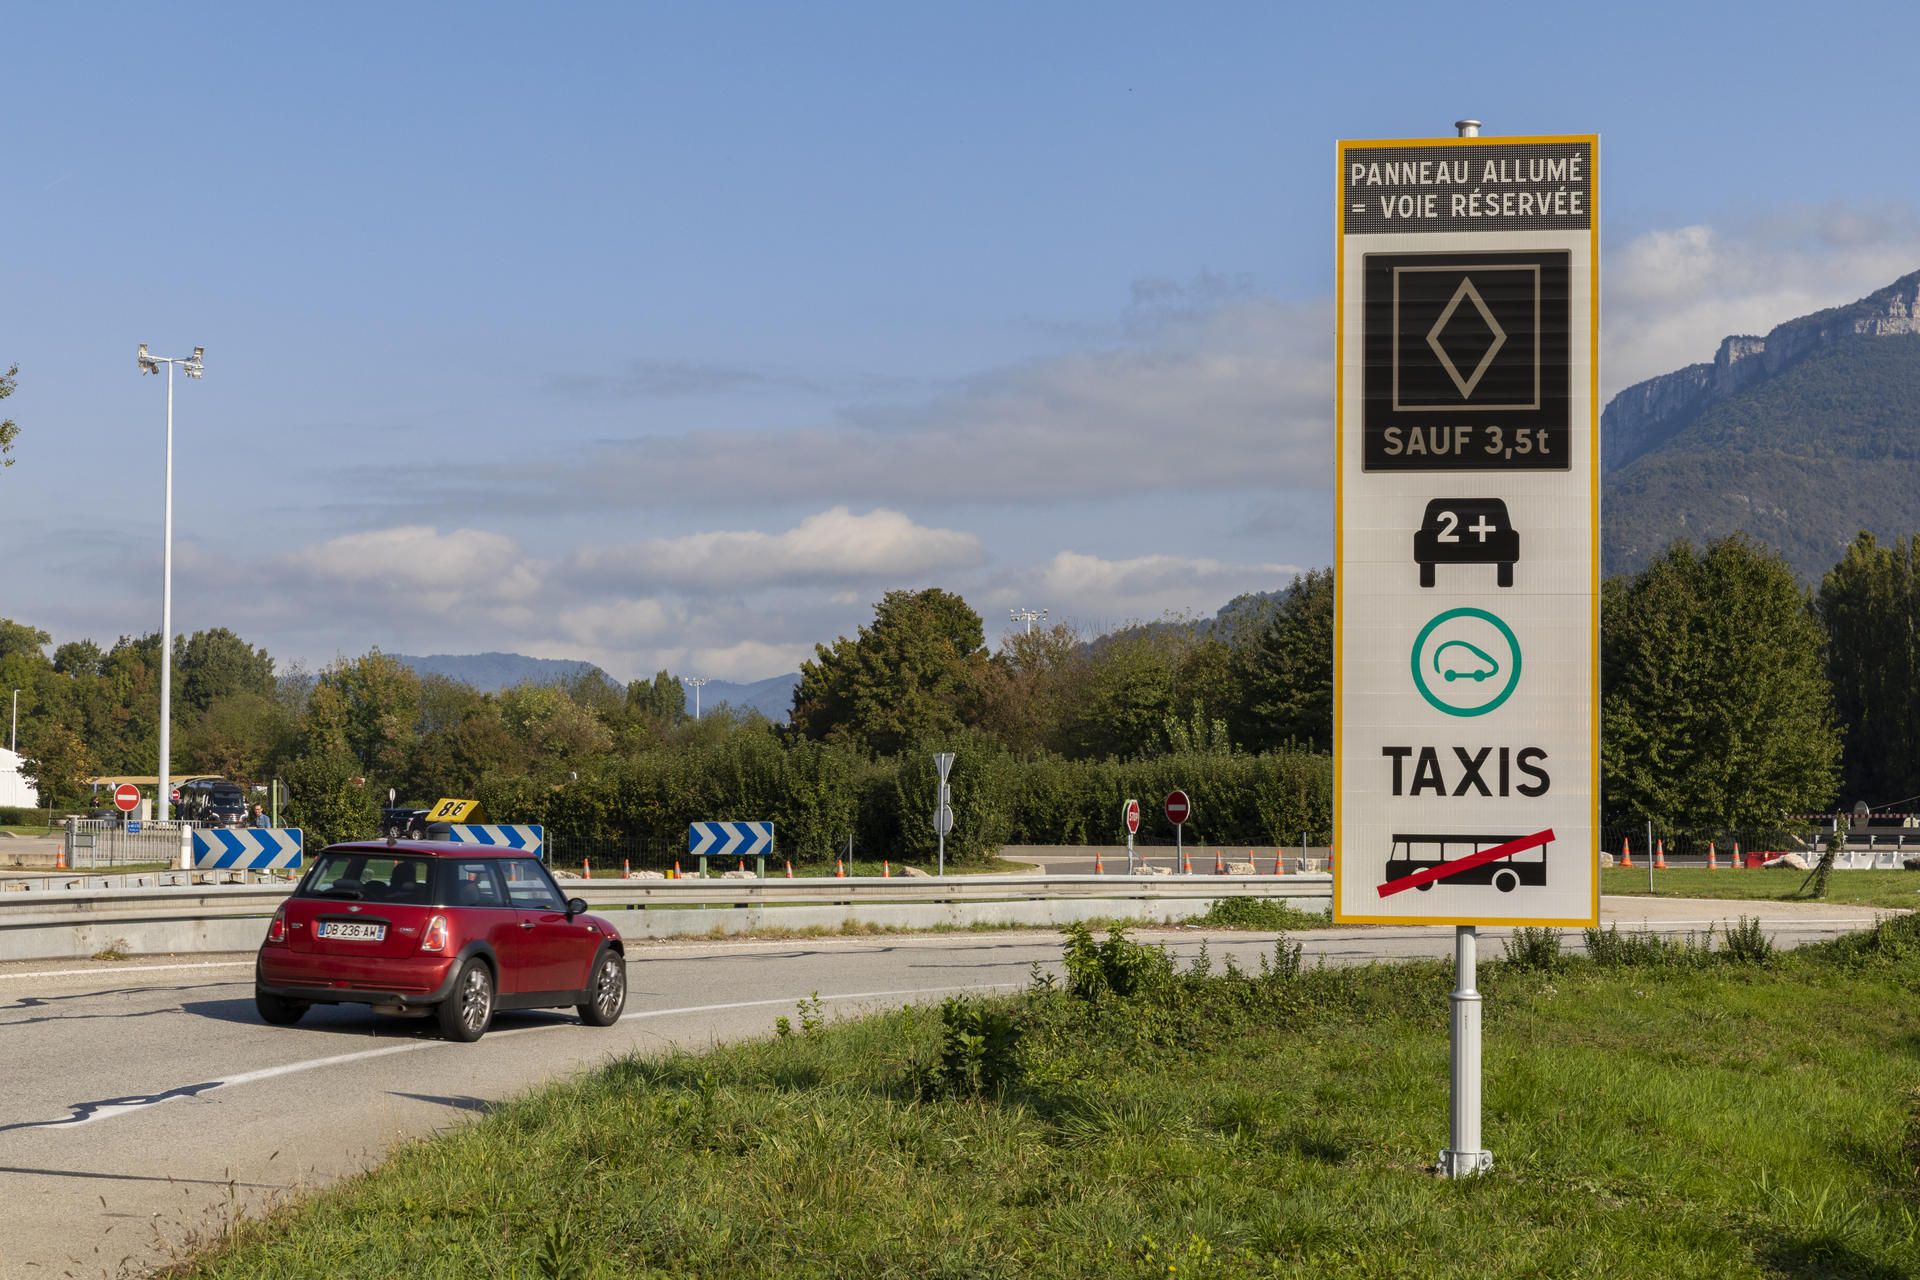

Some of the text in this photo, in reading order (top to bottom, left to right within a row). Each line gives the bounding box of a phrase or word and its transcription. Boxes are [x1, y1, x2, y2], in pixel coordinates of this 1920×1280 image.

[1351, 153, 1583, 186] PANNEAU ALLUMÉ
[1380, 194, 1438, 219] VOIE
[1451, 186, 1584, 217] RÉSERVÉE
[1383, 425, 1550, 459] SAUF 3,5t
[1382, 746, 1551, 798] TAXIS
[437, 801, 467, 817] 86
[1129, 811, 1139, 821] STOP
